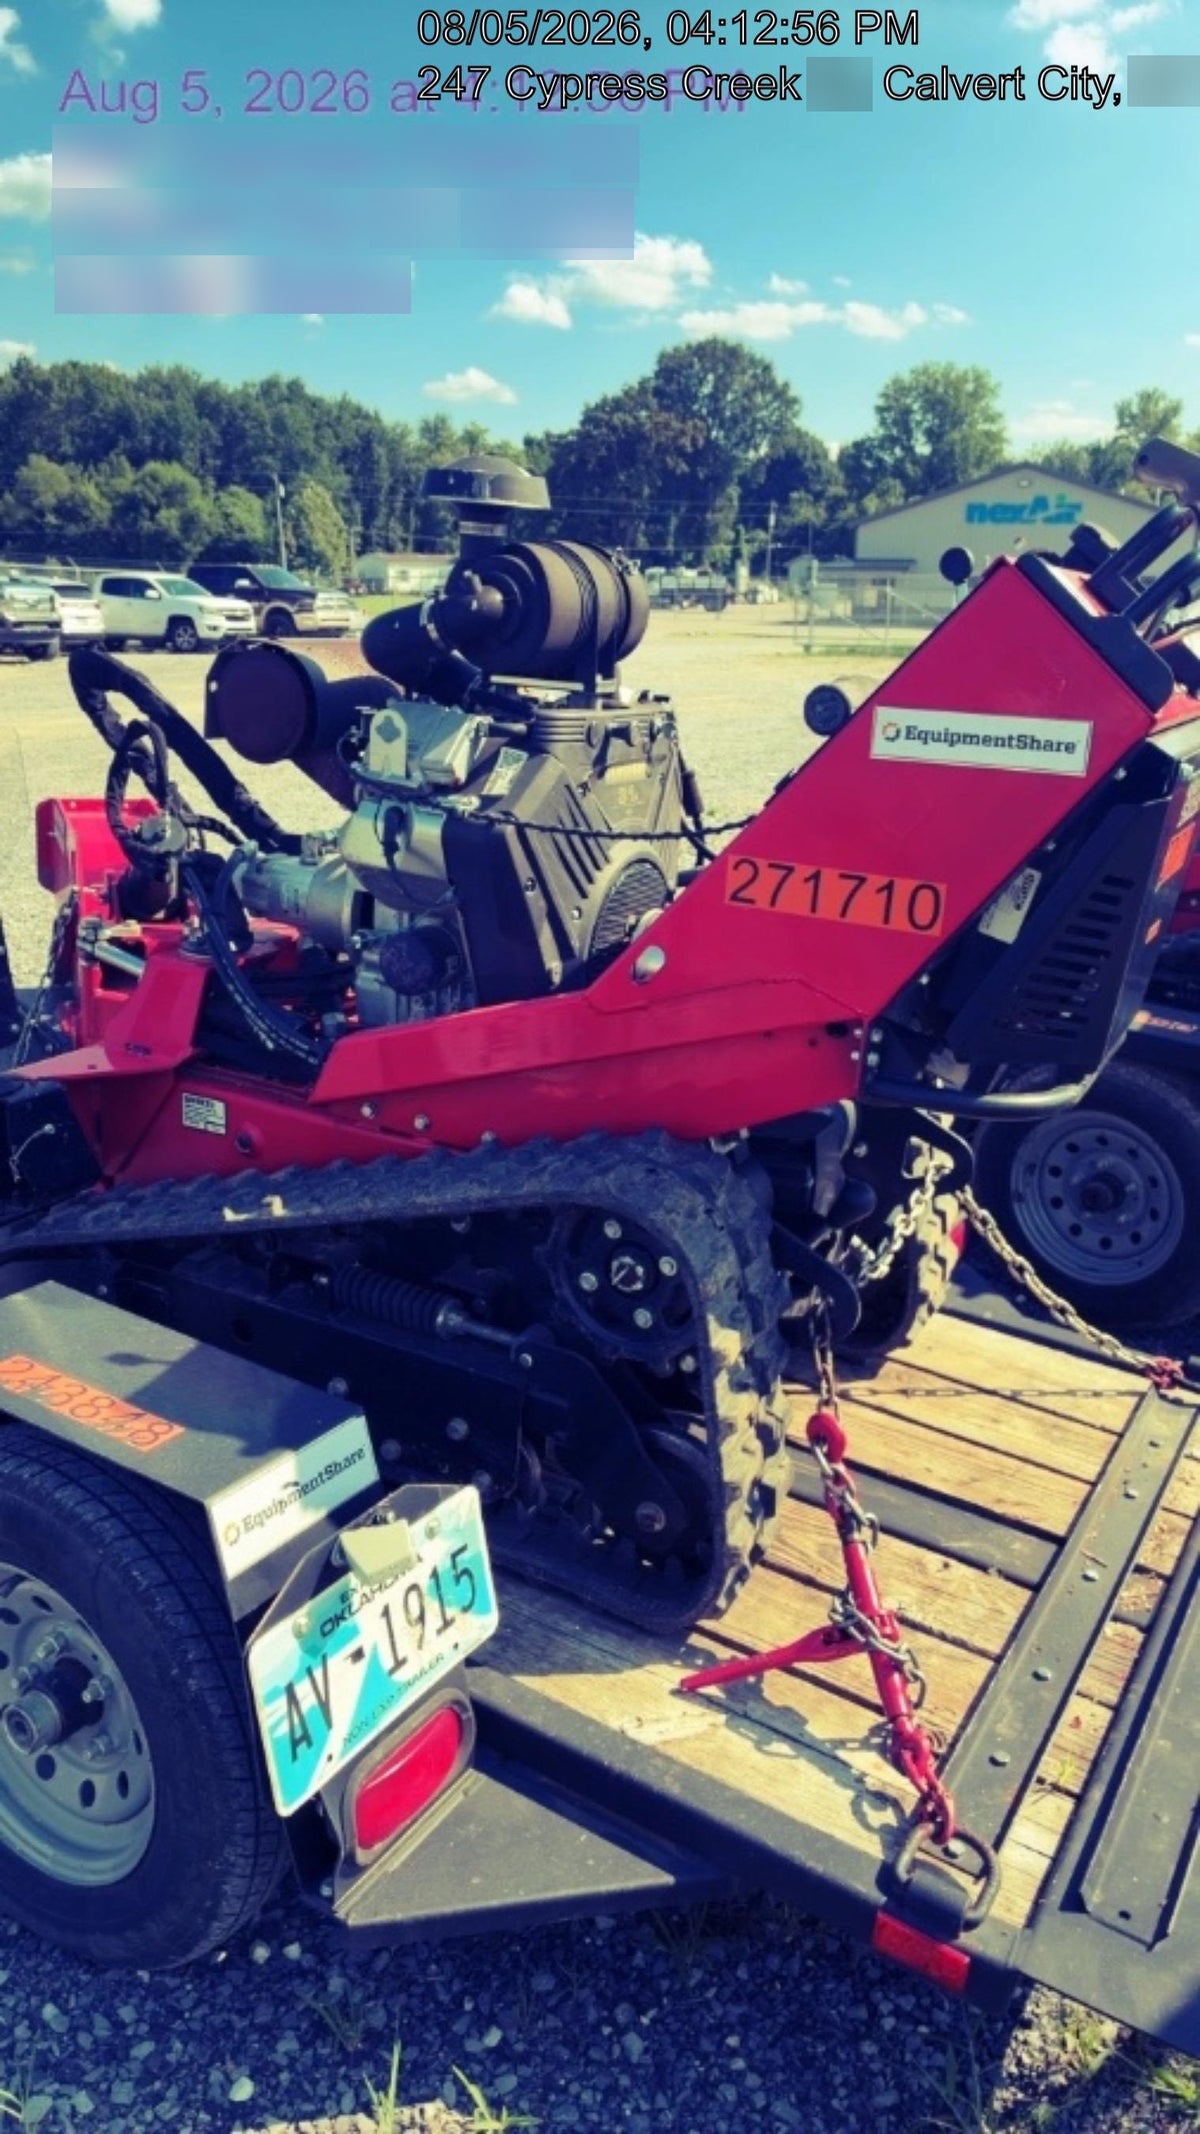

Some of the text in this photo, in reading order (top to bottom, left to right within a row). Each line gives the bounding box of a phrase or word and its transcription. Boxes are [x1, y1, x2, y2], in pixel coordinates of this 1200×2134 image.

[904, 725, 1077, 755] EquipmentShare
[728, 857, 942, 932] 271710
[241, 1447, 366, 1533] EquipmentShare
